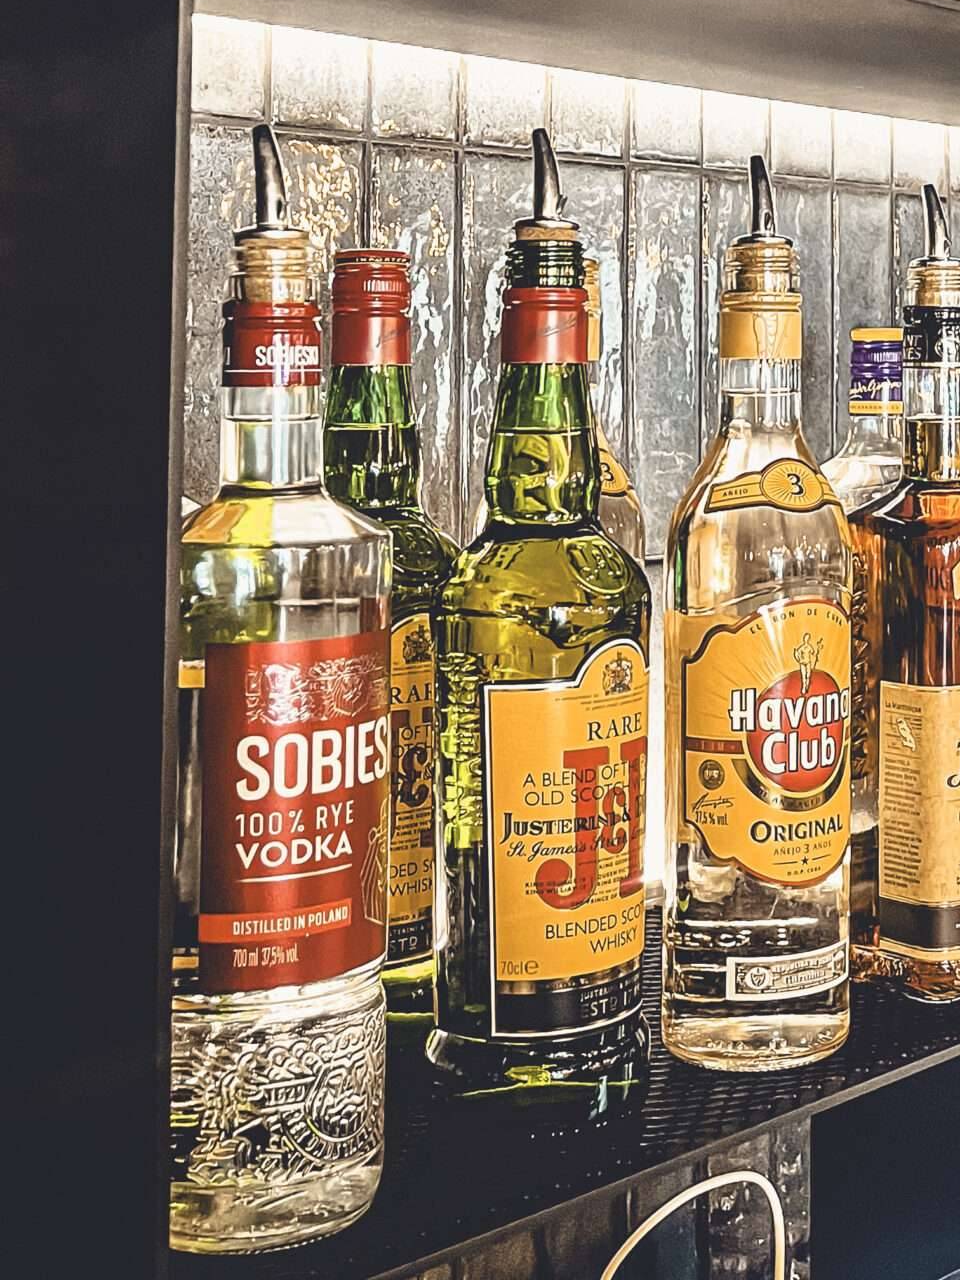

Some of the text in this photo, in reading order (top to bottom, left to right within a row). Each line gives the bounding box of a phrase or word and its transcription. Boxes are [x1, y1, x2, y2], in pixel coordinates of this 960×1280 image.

[786, 472, 807, 498] 3
[587, 711, 642, 742] RARE
[760, 727, 838, 777] Club
[522, 773, 536, 788] A
[542, 768, 597, 788] BLEND
[525, 790, 564, 806] OLD
[235, 799, 354, 838] 100% RYE
[235, 830, 353, 870] VODKA
[773, 846, 801, 857] AÑEJO
[803, 843, 811, 854] 3
[232, 905, 349, 937] DISTILLED IN POLAND
[545, 914, 619, 940] BLENDED
[589, 926, 638, 954] WHISKY
[232, 948, 248, 968] 700
